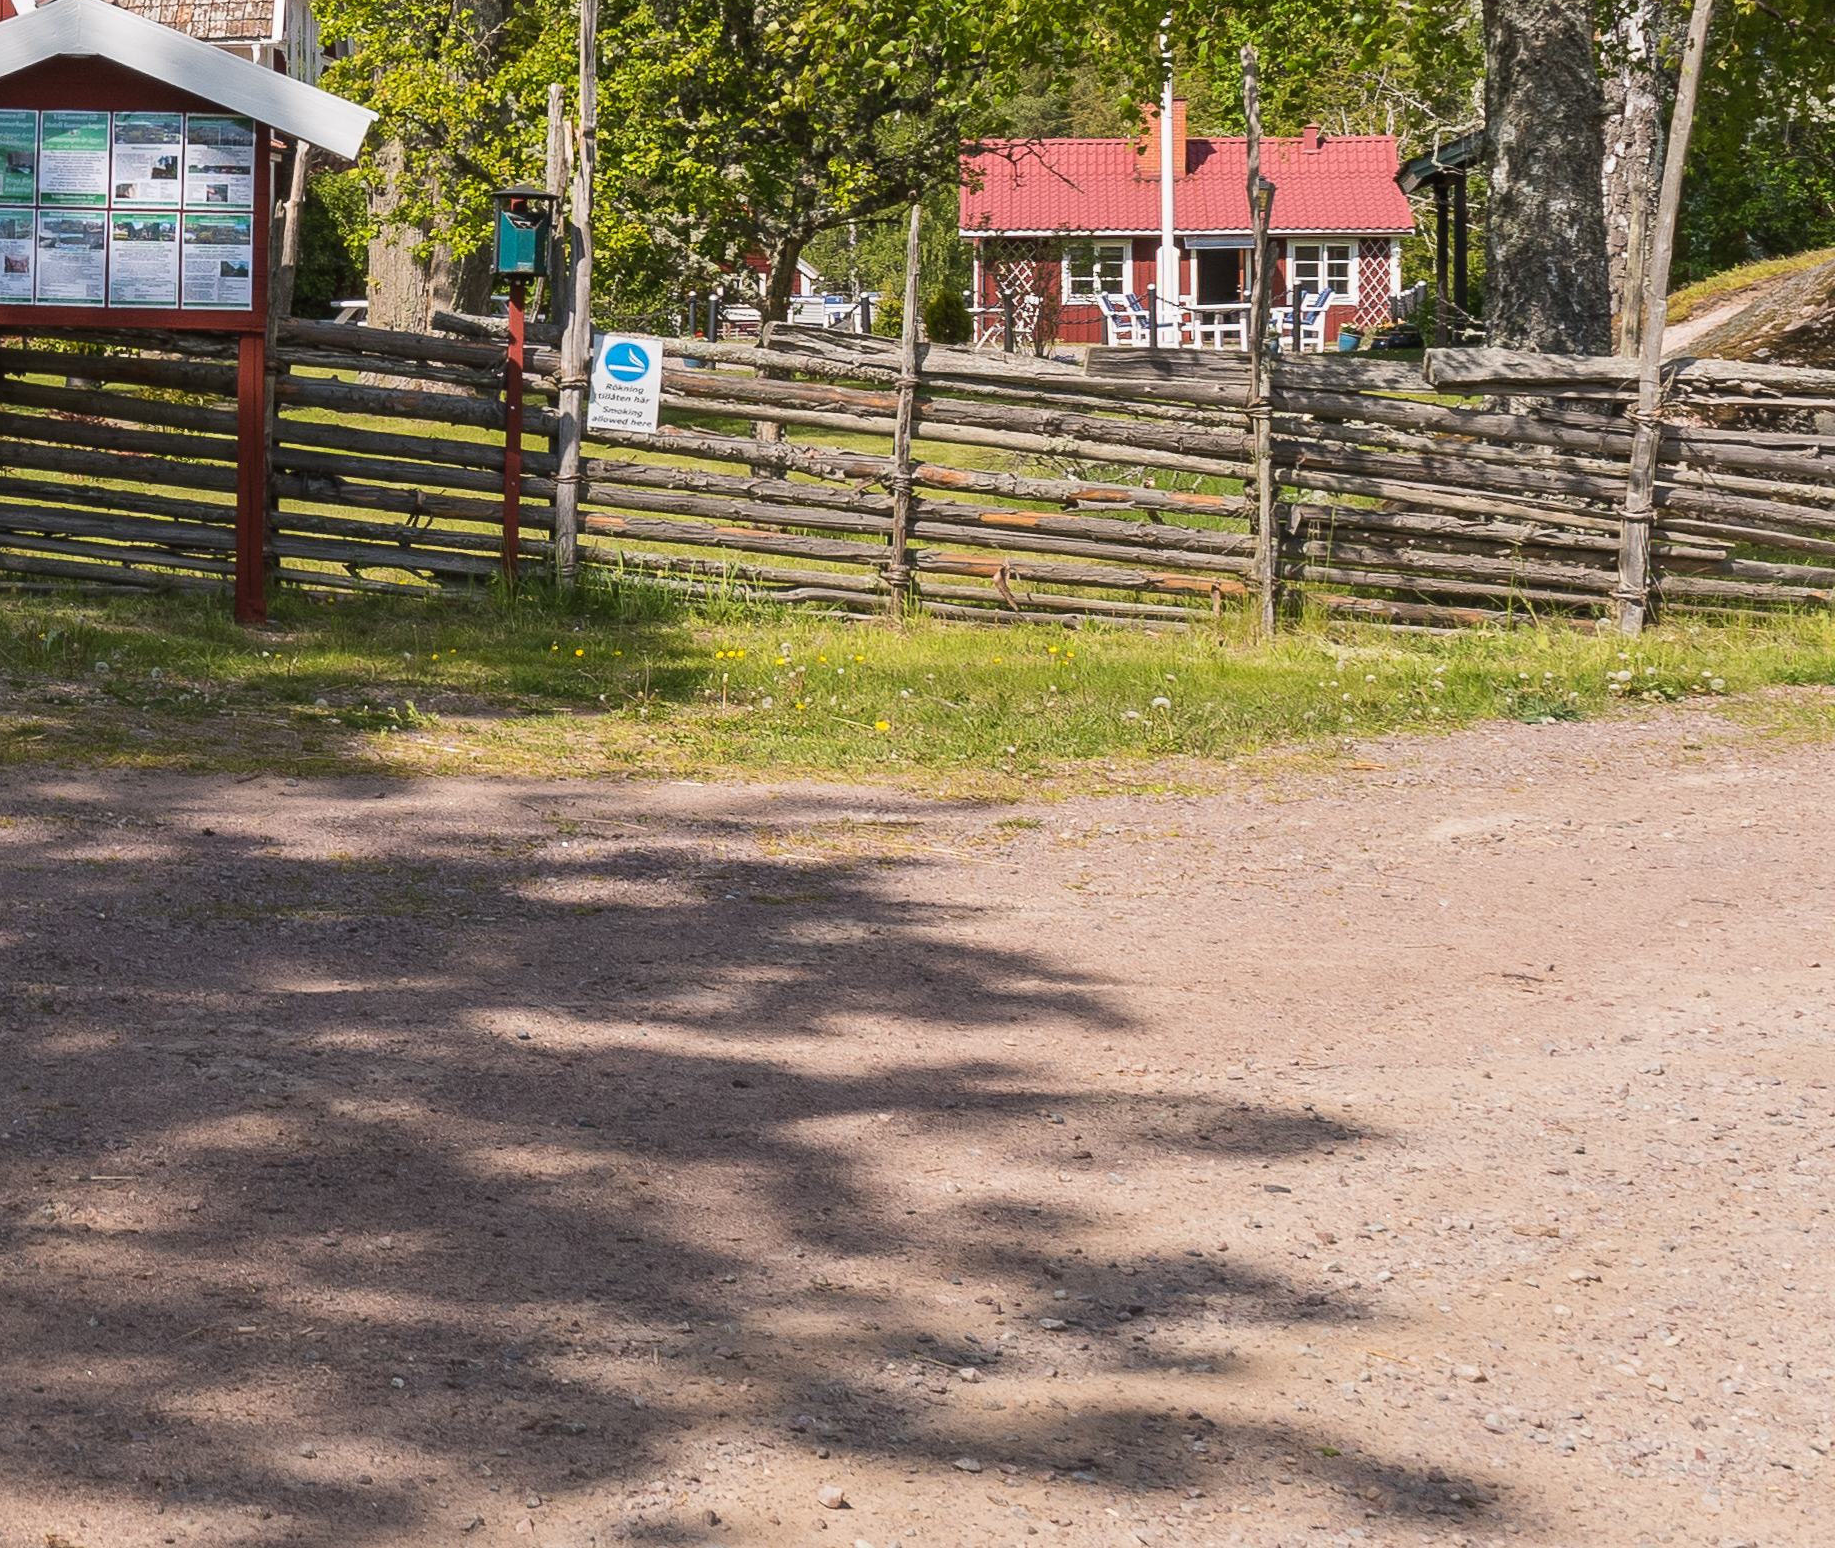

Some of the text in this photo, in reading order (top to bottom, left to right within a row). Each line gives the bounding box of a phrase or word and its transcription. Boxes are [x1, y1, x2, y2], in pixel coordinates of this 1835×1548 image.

[606, 383, 644, 394] Rökning
[634, 396, 651, 404] här
[603, 406, 643, 417] Smoking
[592, 416, 652, 427] allowed here
